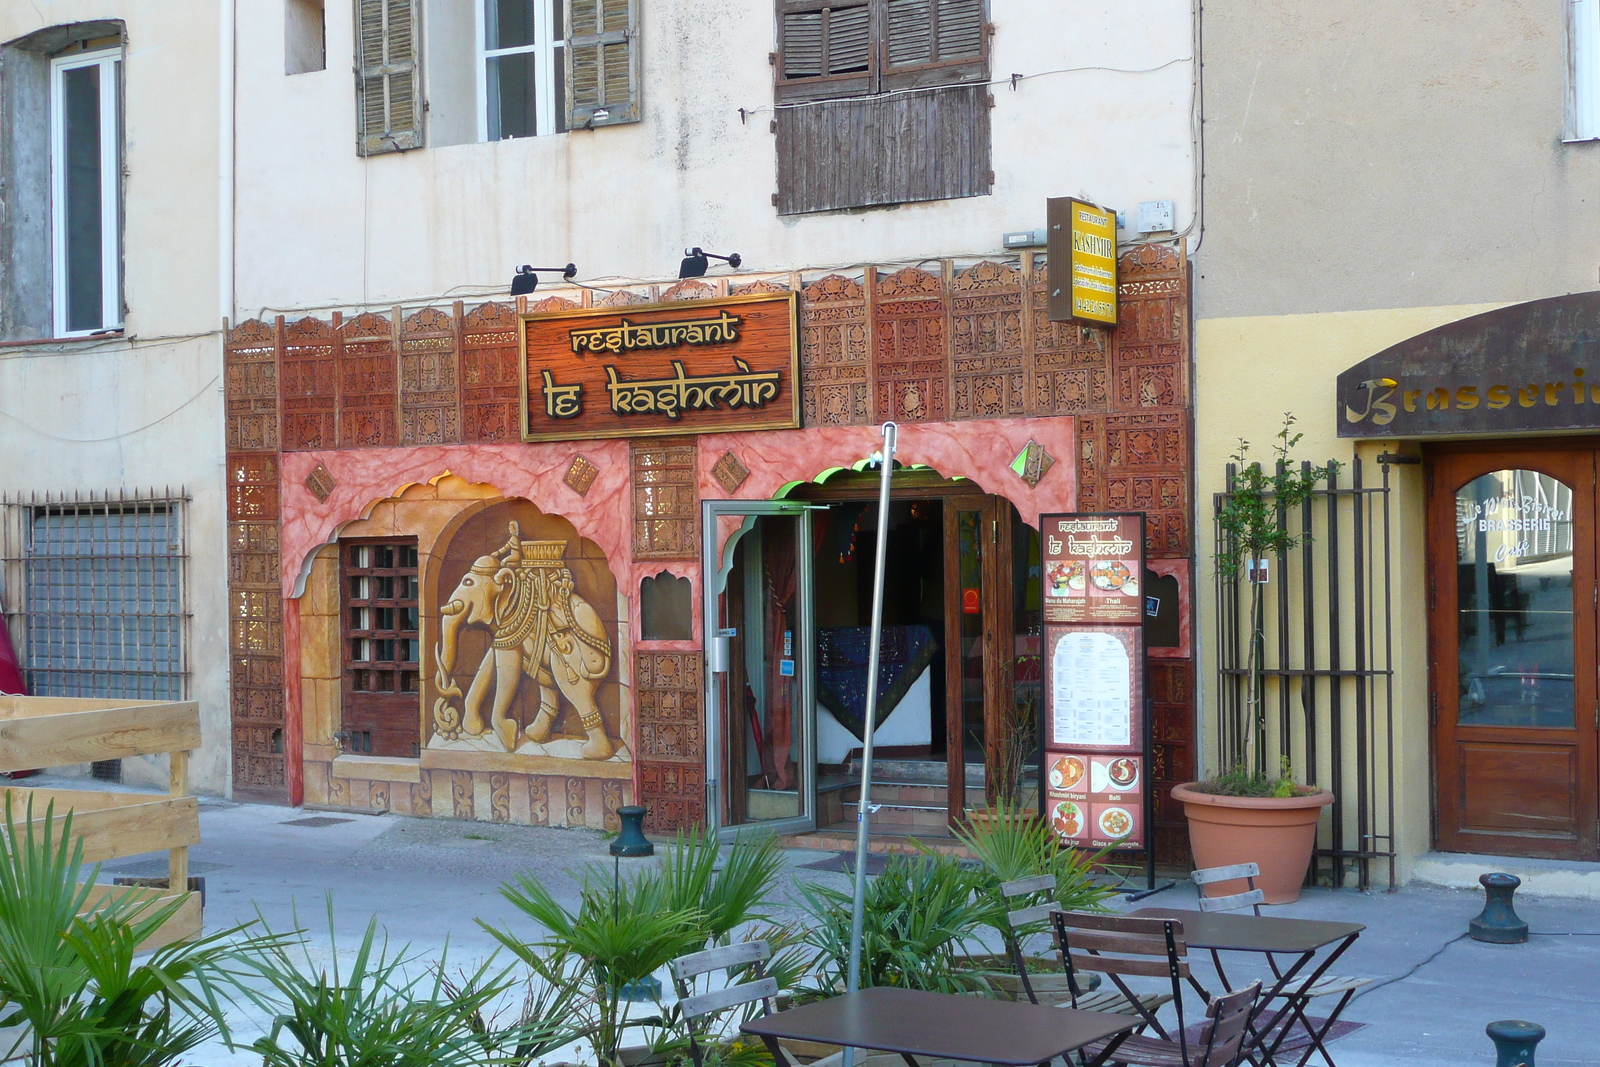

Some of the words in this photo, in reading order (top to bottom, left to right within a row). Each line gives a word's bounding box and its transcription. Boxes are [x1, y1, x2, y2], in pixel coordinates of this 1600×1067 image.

[1079, 211, 1107, 227] RESTAURANT
[1074, 231, 1113, 258] KASHMIR
[1075, 297, 1082, 311] 04
[1083, 298, 1090, 314] 42
[1462, 503, 1482, 524] Le
[1516, 495, 1564, 520] Bistrot
[1479, 518, 1551, 532] BRASSERIE
[1494, 538, 1530, 563] Café
[1062, 598, 1086, 606] Maharajah
[1070, 793, 1086, 801] biryani
